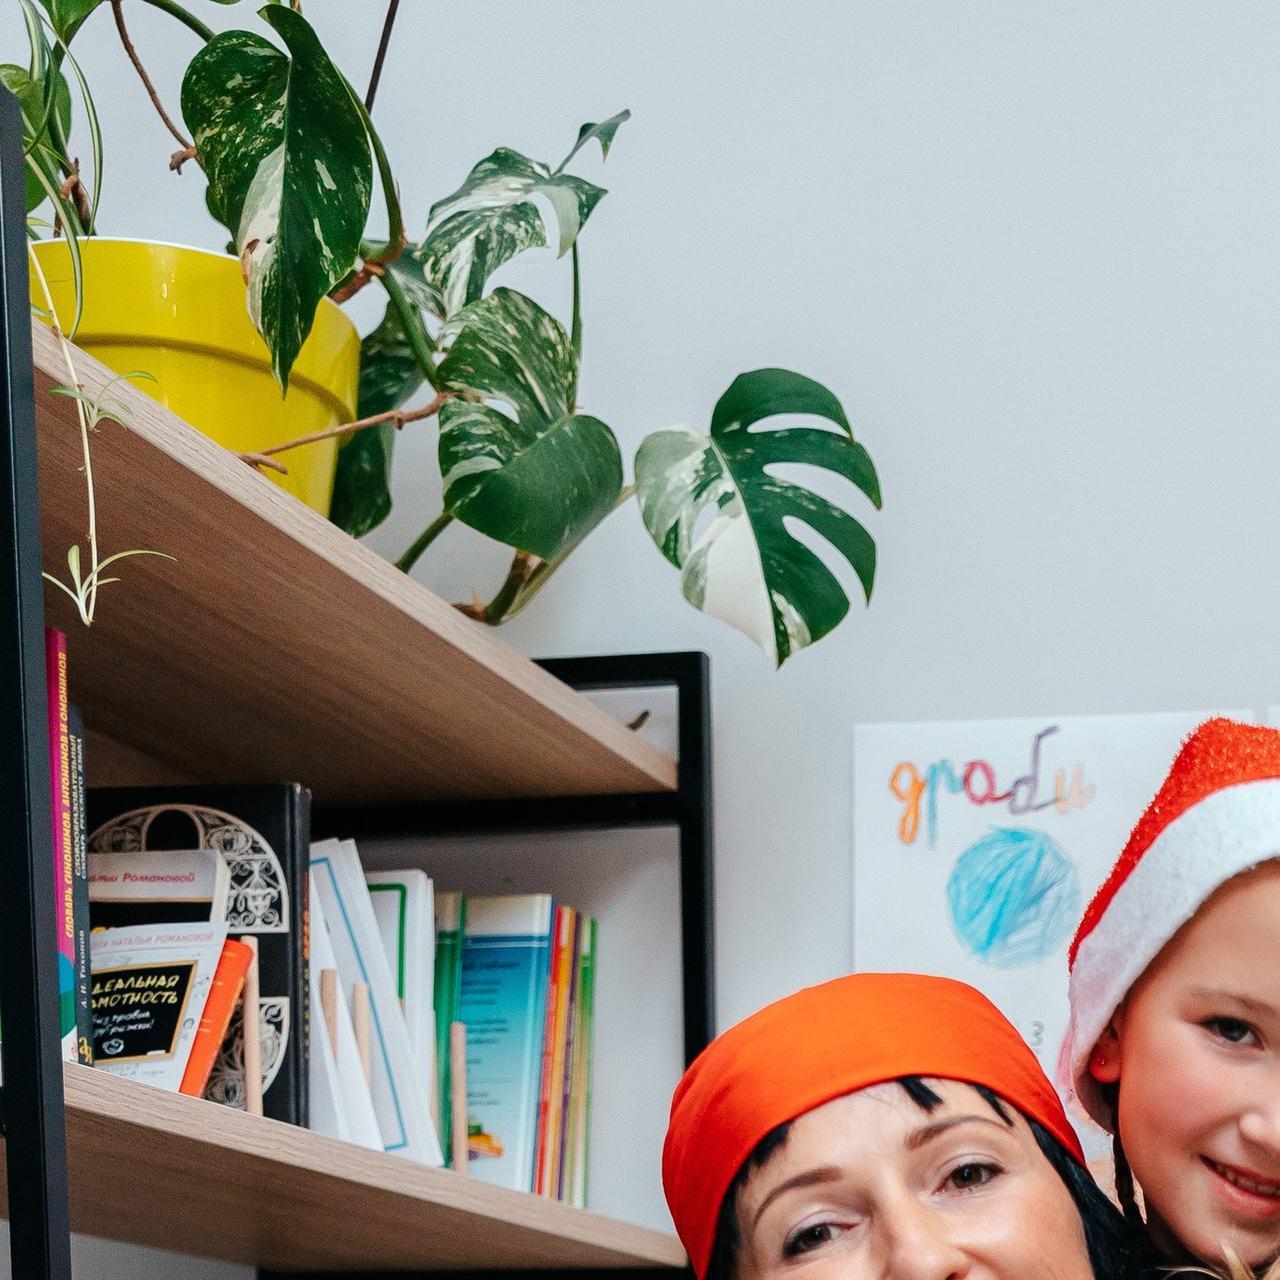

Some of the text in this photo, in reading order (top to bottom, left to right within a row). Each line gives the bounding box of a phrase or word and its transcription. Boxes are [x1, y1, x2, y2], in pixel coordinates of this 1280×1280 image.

[58, 652, 68, 720] ОМОНИМОВ
[60, 734, 70, 806] АНТОНИМОВ
[122, 872, 196, 884] Романовой
[65, 887, 74, 938] СЛОВАРЬ
[91, 975, 180, 995] ДЕАЛЬНАЯ
[91, 991, 178, 1009] АМОТНОСТЬ
